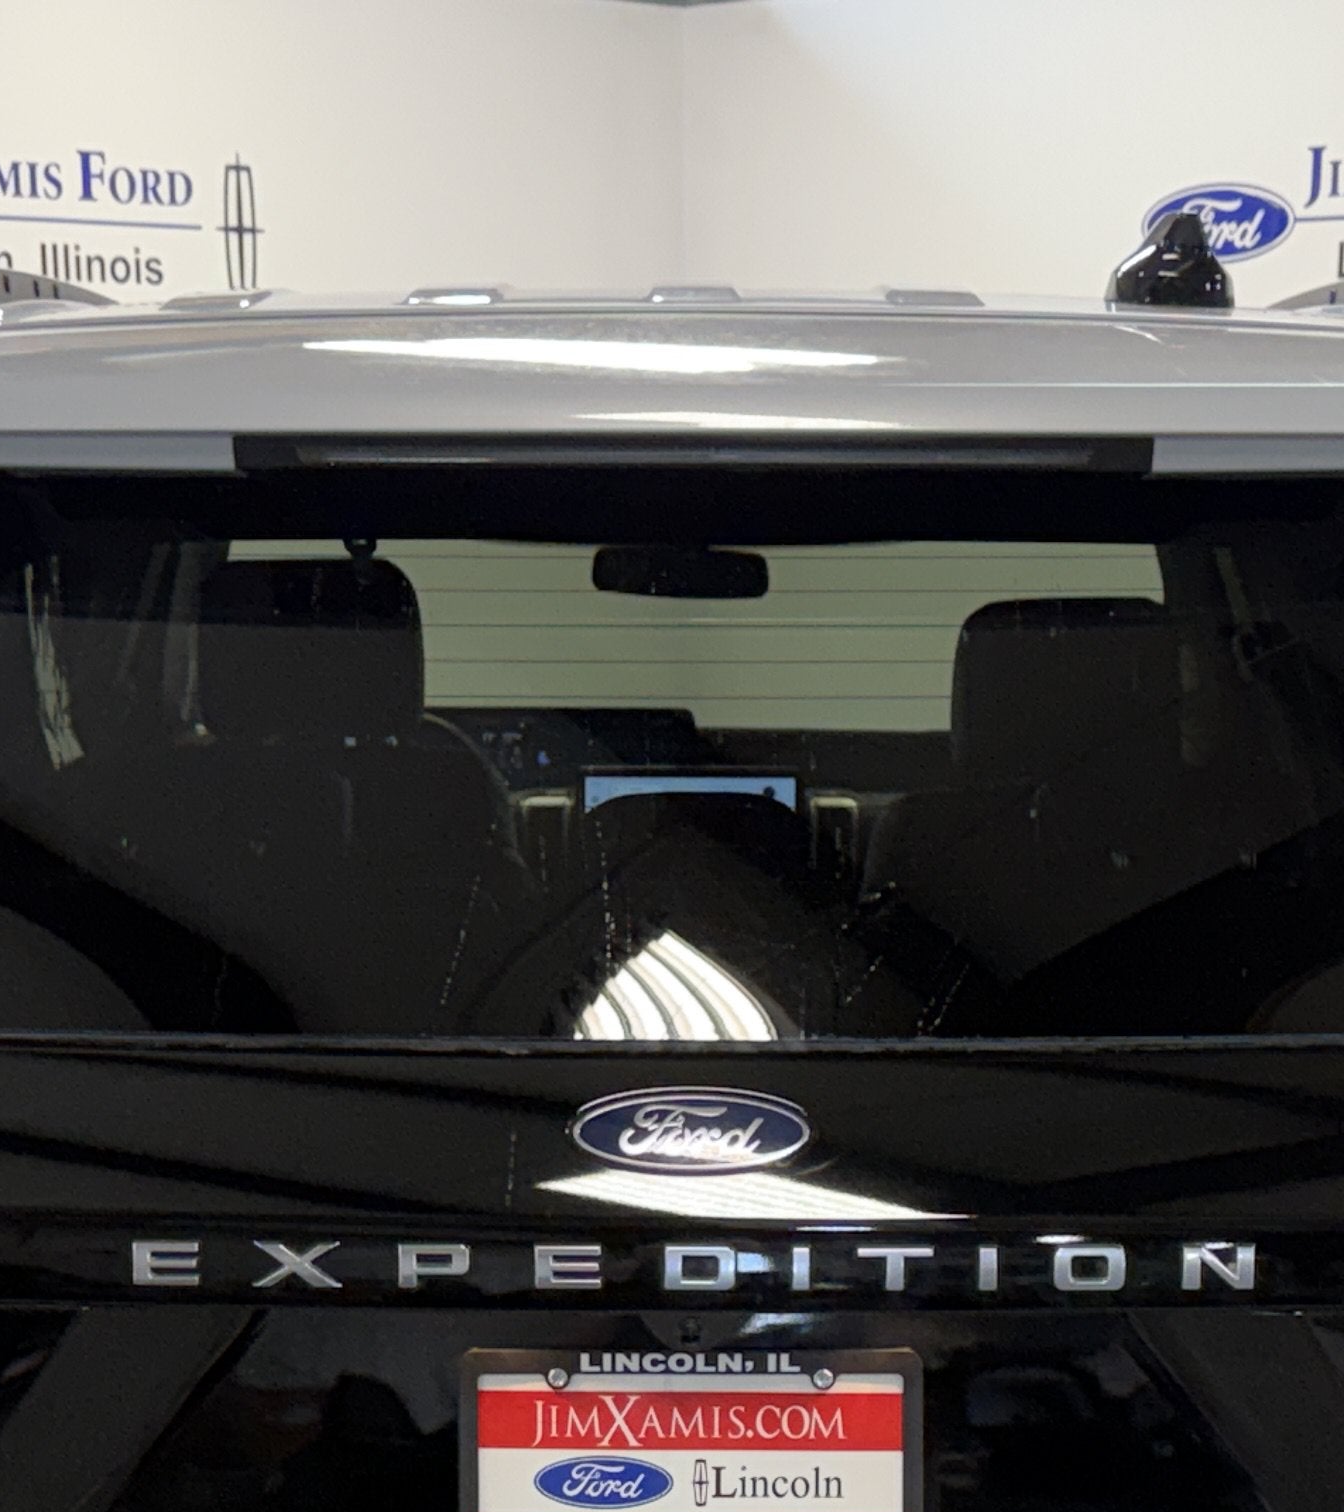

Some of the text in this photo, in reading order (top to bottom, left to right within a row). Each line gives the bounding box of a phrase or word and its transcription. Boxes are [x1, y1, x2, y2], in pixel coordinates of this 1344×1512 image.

[77, 150, 193, 207] FORD
[40, 242, 164, 284] Illinois
[619, 1104, 764, 1158] Ford
[131, 1239, 1257, 1292] EXPEDITION
[580, 1352, 801, 1373] LINCOLN, IL
[532, 1395, 847, 1447] JIMXAMIS.COM
[562, 1463, 643, 1499] Ford
[711, 1466, 843, 1499] Lincoln
